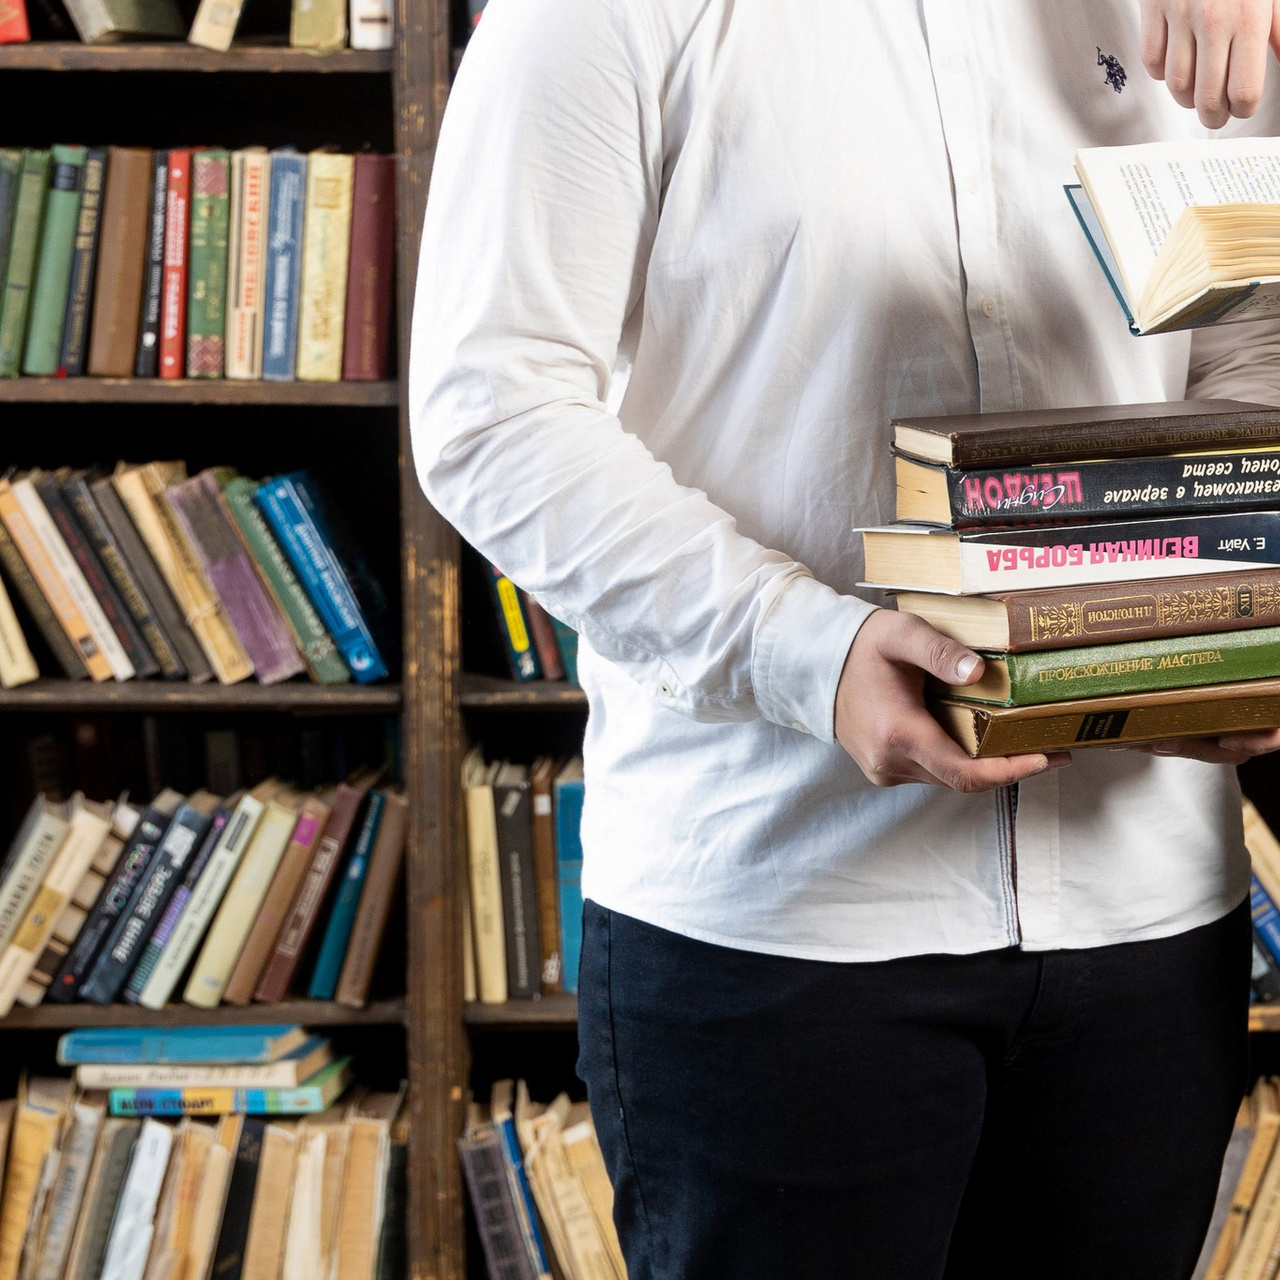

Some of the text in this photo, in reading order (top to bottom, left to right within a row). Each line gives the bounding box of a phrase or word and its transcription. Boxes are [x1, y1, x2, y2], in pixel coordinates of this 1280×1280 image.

[1053, 433, 1156, 453] АВТОМАТИЧЕСКИЕ
[1166, 427, 1229, 445] ЦИФРОВЫЕ
[1183, 462, 1233, 479] света
[965, 471, 1083, 510] ШЕЛДОН
[996, 482, 1067, 510] Сидни
[1104, 485, 1169, 504] зеркале
[1176, 484, 1186, 498] в
[986, 535, 1266, 572] Е. Уайт ВЕЛИКАЯ БОРЬБА
[1038, 649, 1224, 685] ПРОИСХОЖДЕНИЕ МАСТЕРА
[108, 861, 174, 965] АННА ЗЕГЕРС
